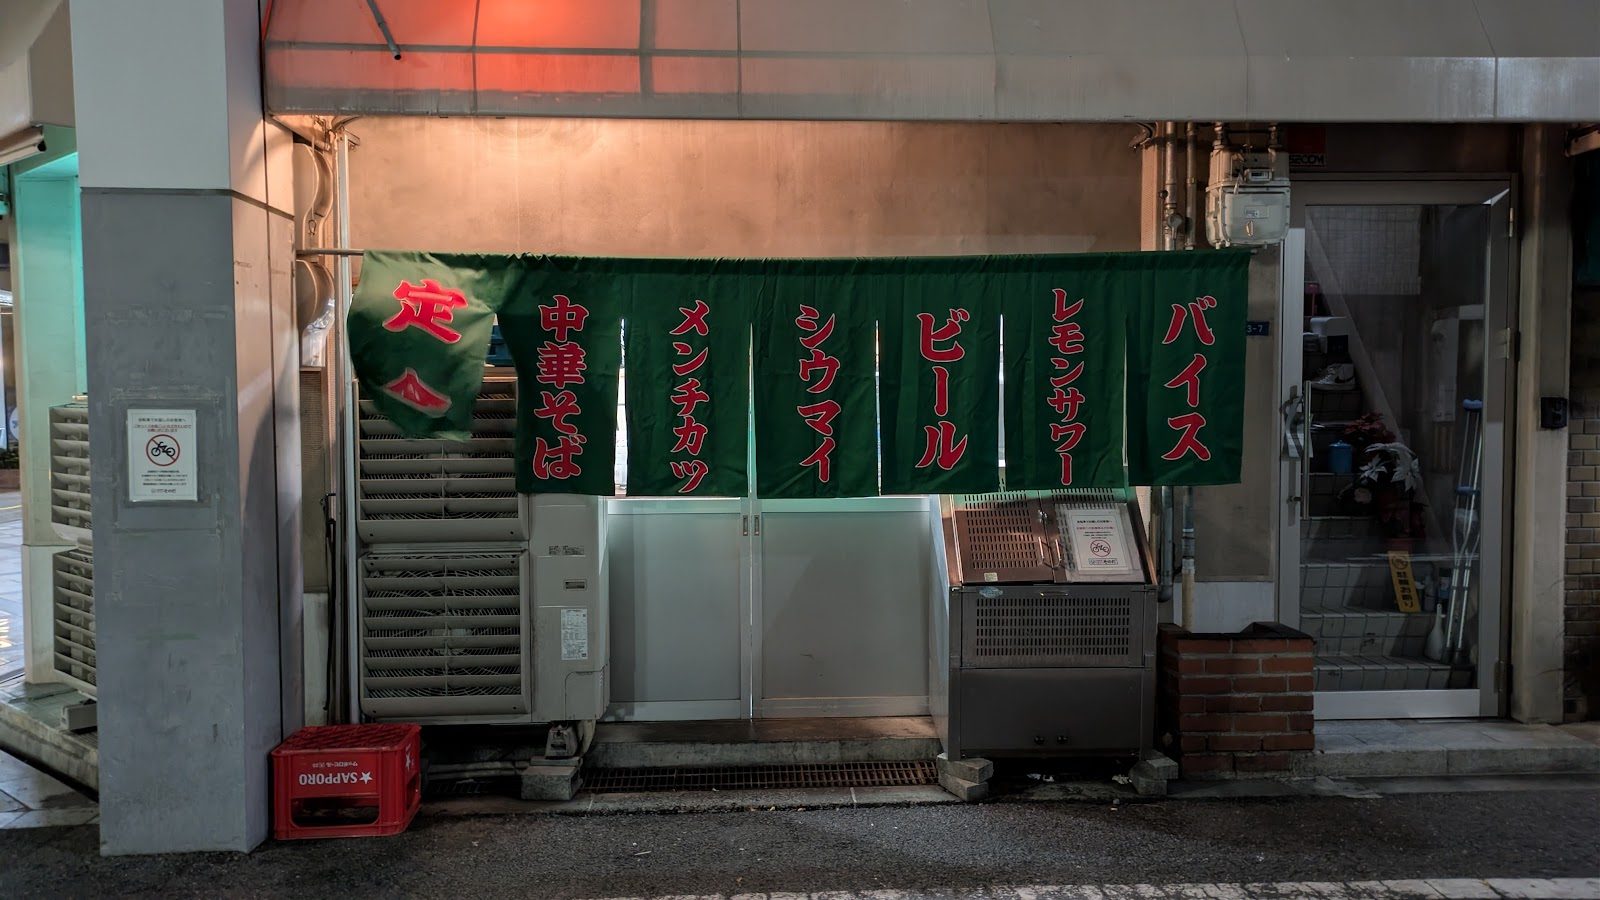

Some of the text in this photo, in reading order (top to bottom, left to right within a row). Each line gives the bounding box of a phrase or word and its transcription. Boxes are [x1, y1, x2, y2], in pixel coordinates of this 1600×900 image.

[532, 294, 589, 480] 中華そば
[669, 299, 710, 493] メンチカツ
[795, 303, 842, 483] シウマイ
[915, 308, 970, 471] ビール
[1047, 288, 1086, 486] レモンサワー
[1161, 295, 1218, 462] バイス
[299, 772, 358, 785] SAPPORO
